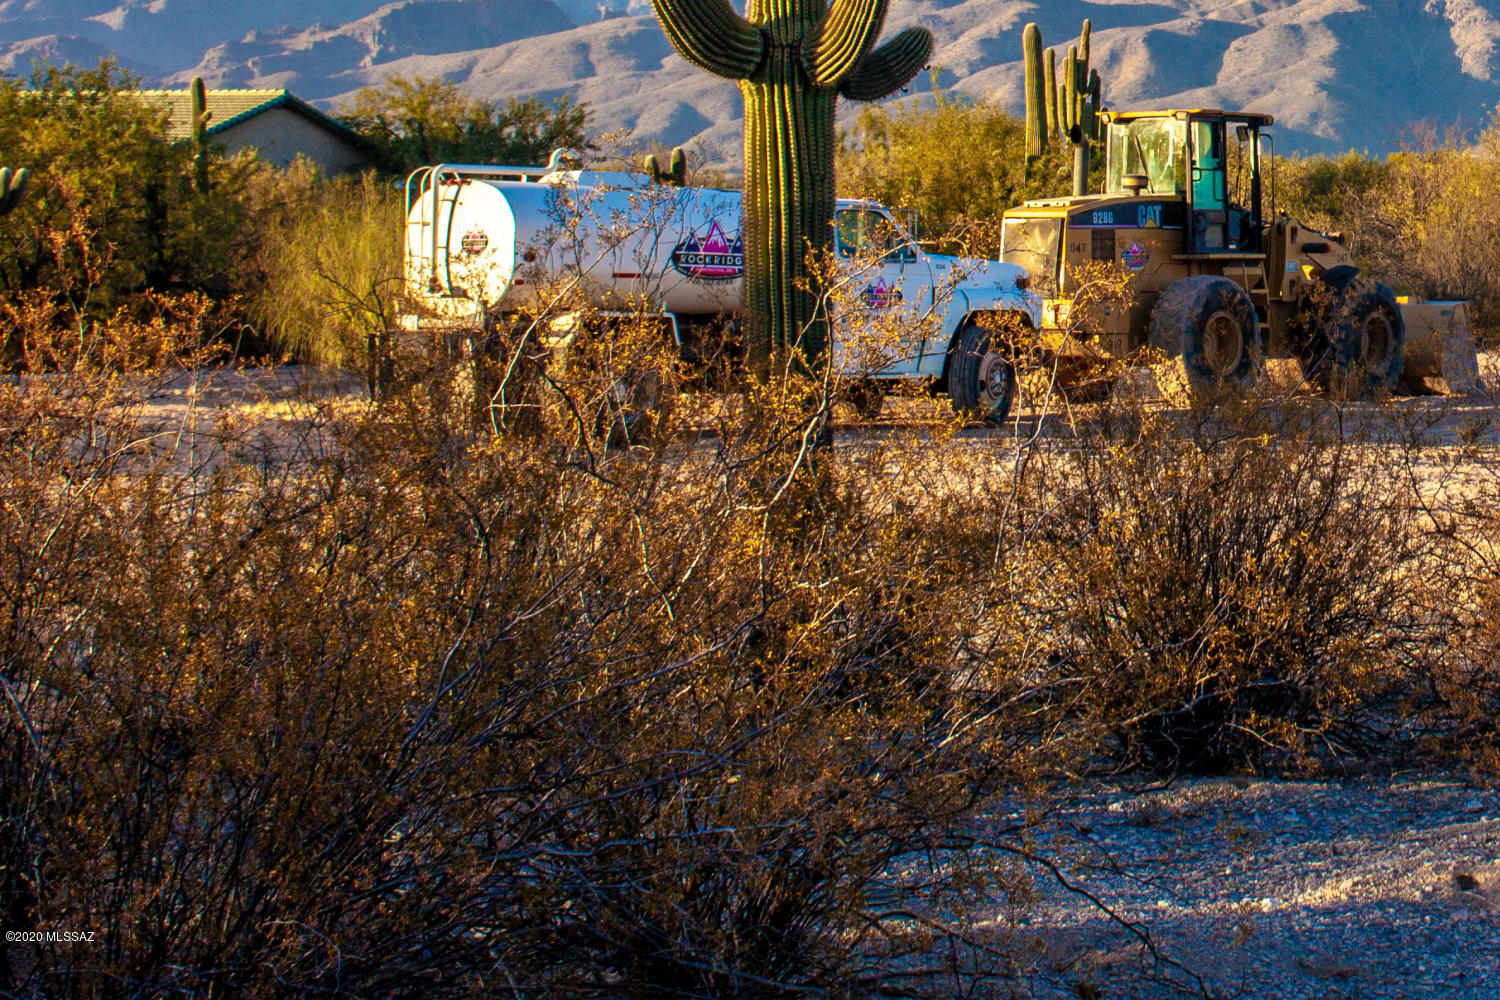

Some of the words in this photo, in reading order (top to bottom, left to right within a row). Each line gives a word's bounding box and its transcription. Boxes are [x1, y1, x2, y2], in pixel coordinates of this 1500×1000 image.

[1093, 211, 1114, 224] 928G
[1138, 204, 1162, 228] CAT
[680, 255, 743, 265] ROCKRIDG
